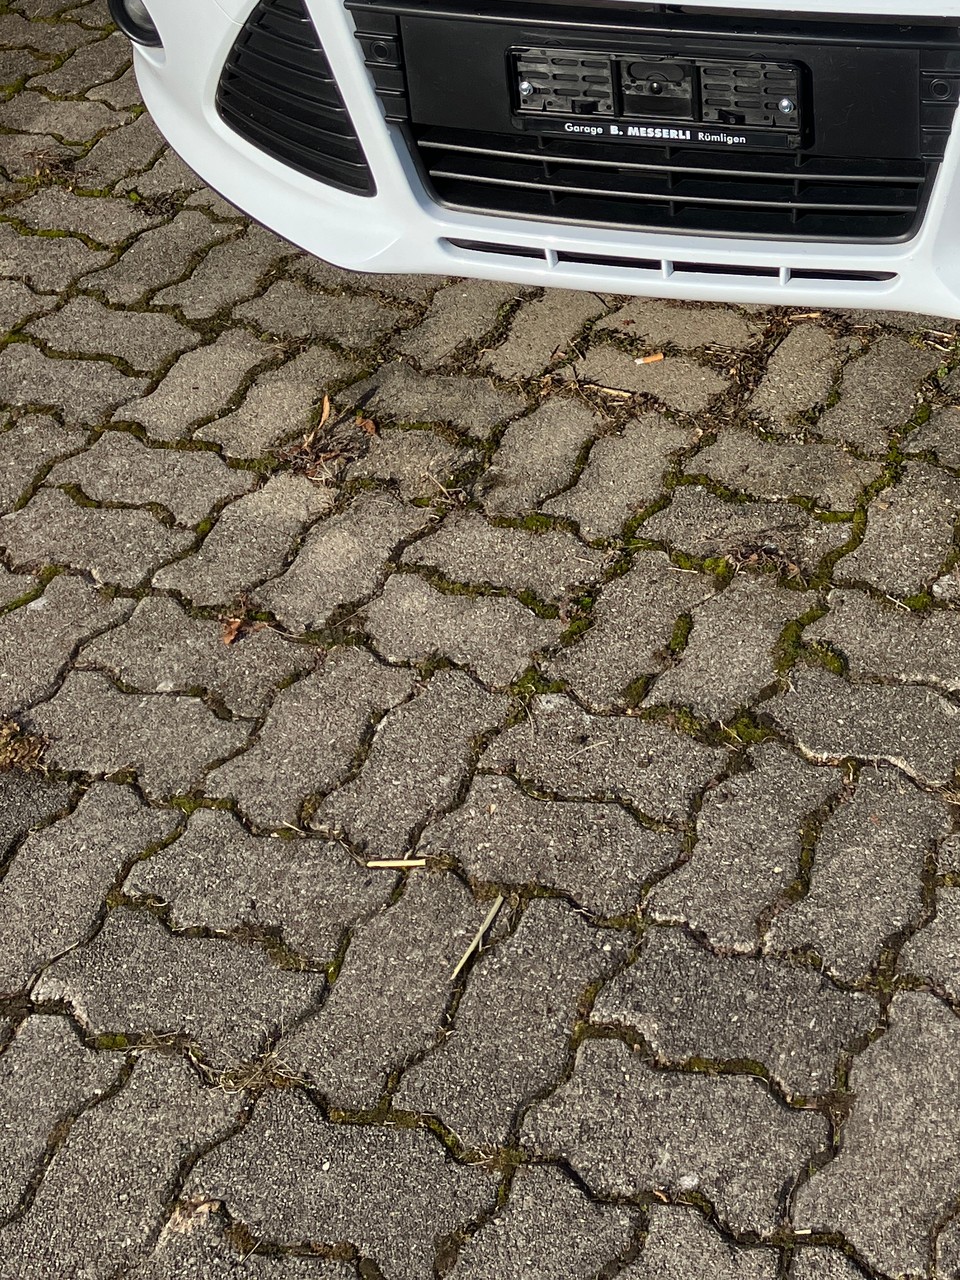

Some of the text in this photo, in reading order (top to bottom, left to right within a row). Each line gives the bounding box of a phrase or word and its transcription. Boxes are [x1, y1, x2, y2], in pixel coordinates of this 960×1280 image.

[564, 123, 746, 144] Garage B. MESSERLI Rümligen
